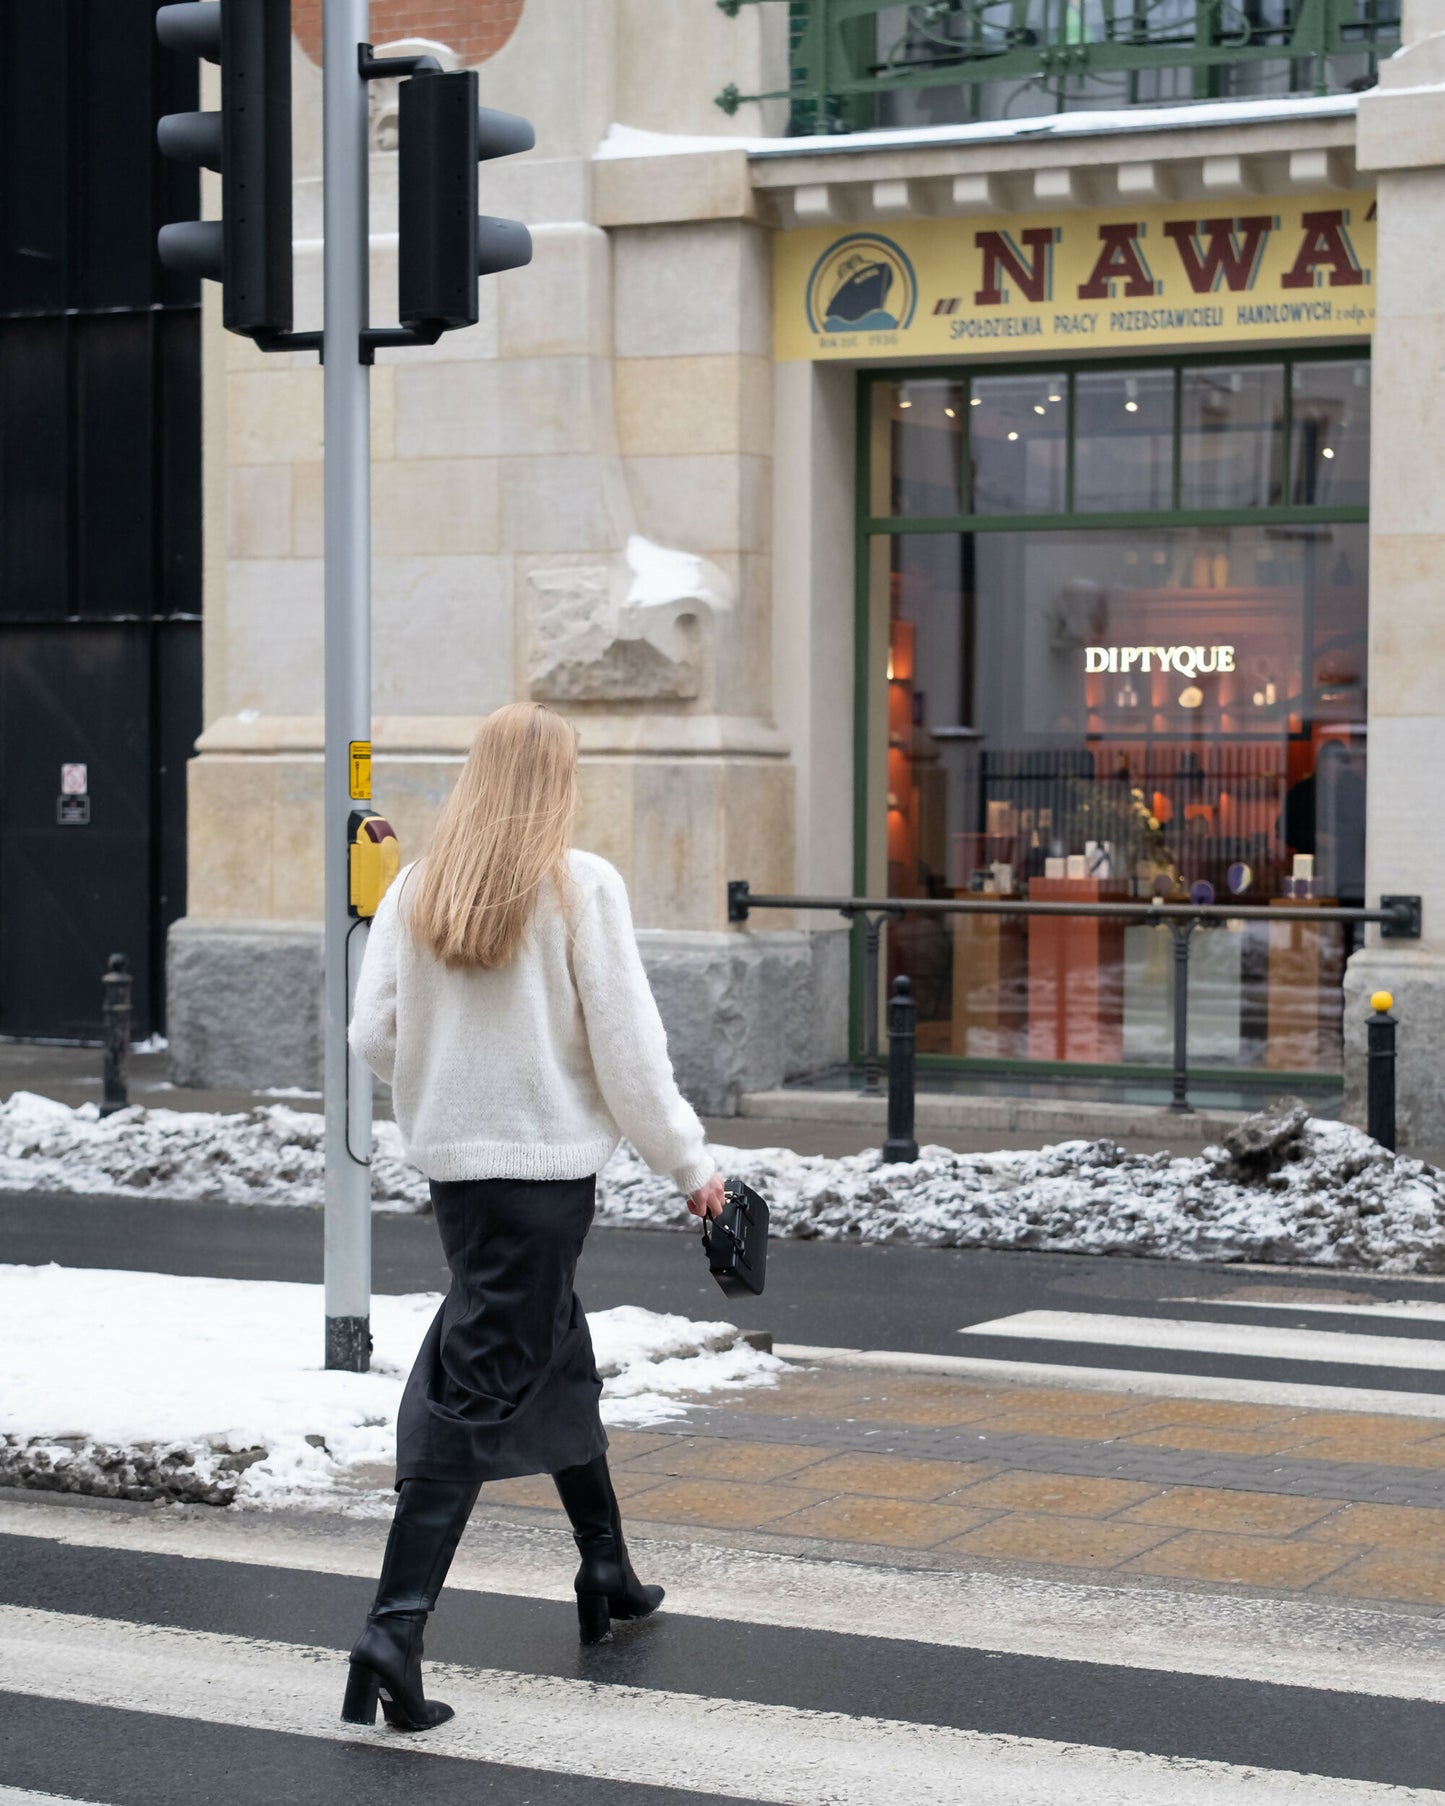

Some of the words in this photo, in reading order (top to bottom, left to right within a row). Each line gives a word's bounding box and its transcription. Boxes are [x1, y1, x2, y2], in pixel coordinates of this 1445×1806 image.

[1053, 313, 1098, 335] PRACY
[1110, 306, 1223, 332] PRZEDSTAWICIELI
[1236, 302, 1331, 326] HANDLOWYCH
[1085, 645, 1235, 678] DIPTYQUE
